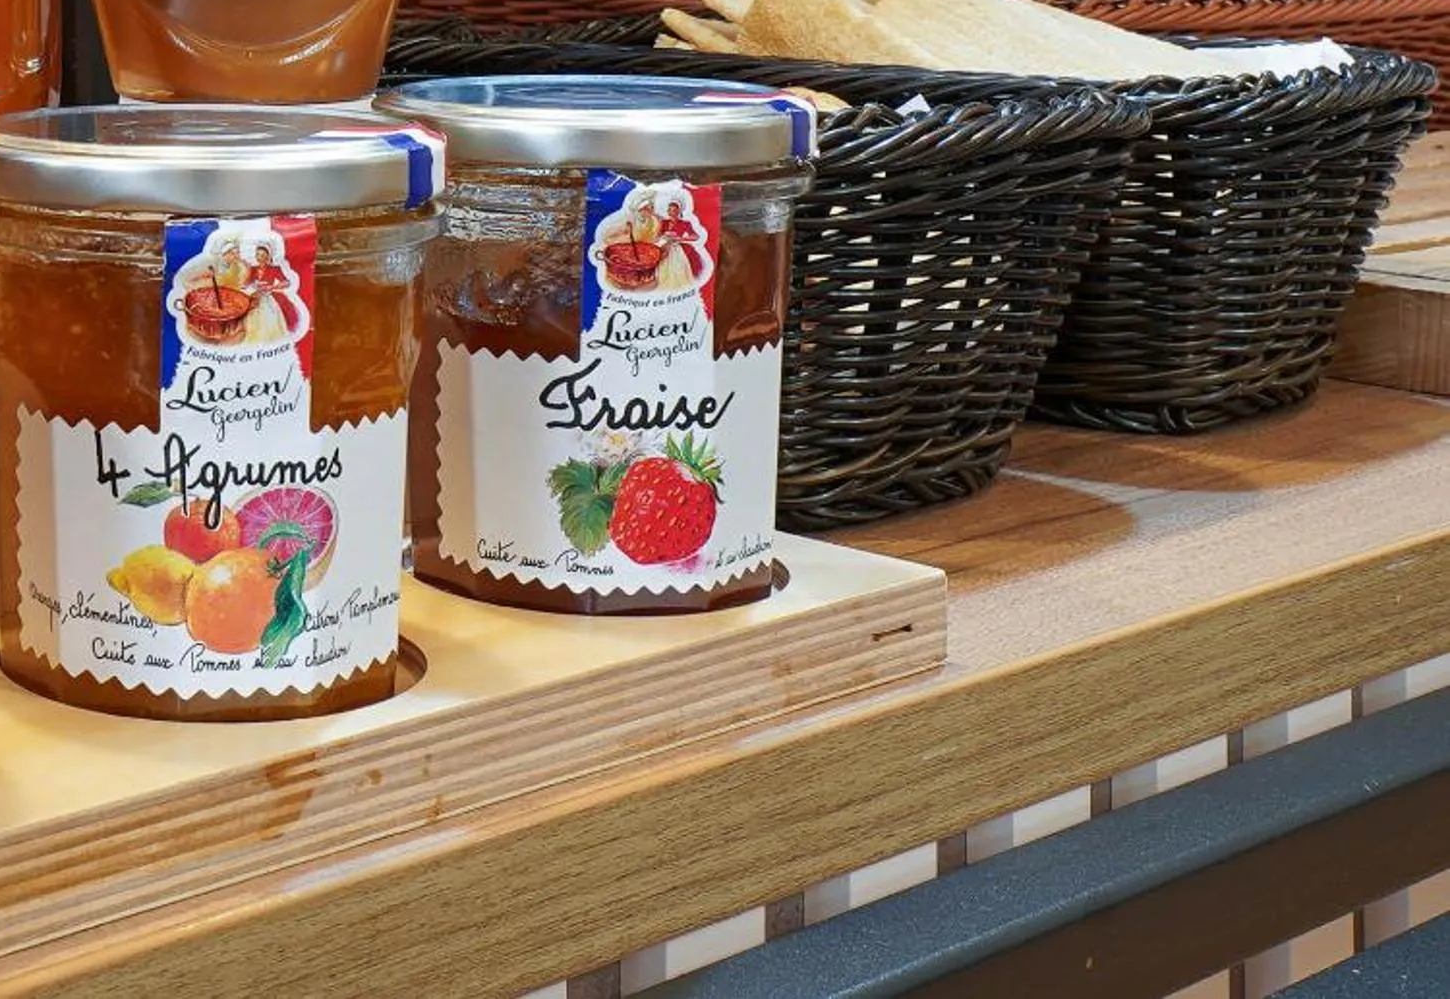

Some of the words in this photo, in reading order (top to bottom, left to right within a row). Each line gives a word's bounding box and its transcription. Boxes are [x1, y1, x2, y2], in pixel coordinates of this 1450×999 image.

[586, 306, 699, 350] Lucien
[625, 328, 708, 378] Georgelin
[186, 345, 237, 366] Fabriqué
[239, 354, 253, 363] en
[256, 341, 291, 360] France
[165, 361, 295, 414] Lucien
[538, 358, 736, 432] Fraise
[210, 389, 302, 443] Georgelin
[95, 430, 131, 498] 4
[144, 433, 343, 530] Agrumes
[554, 548, 614, 576] Pommes
[142, 654, 174, 669] aux
[179, 642, 241, 673] Pommes
